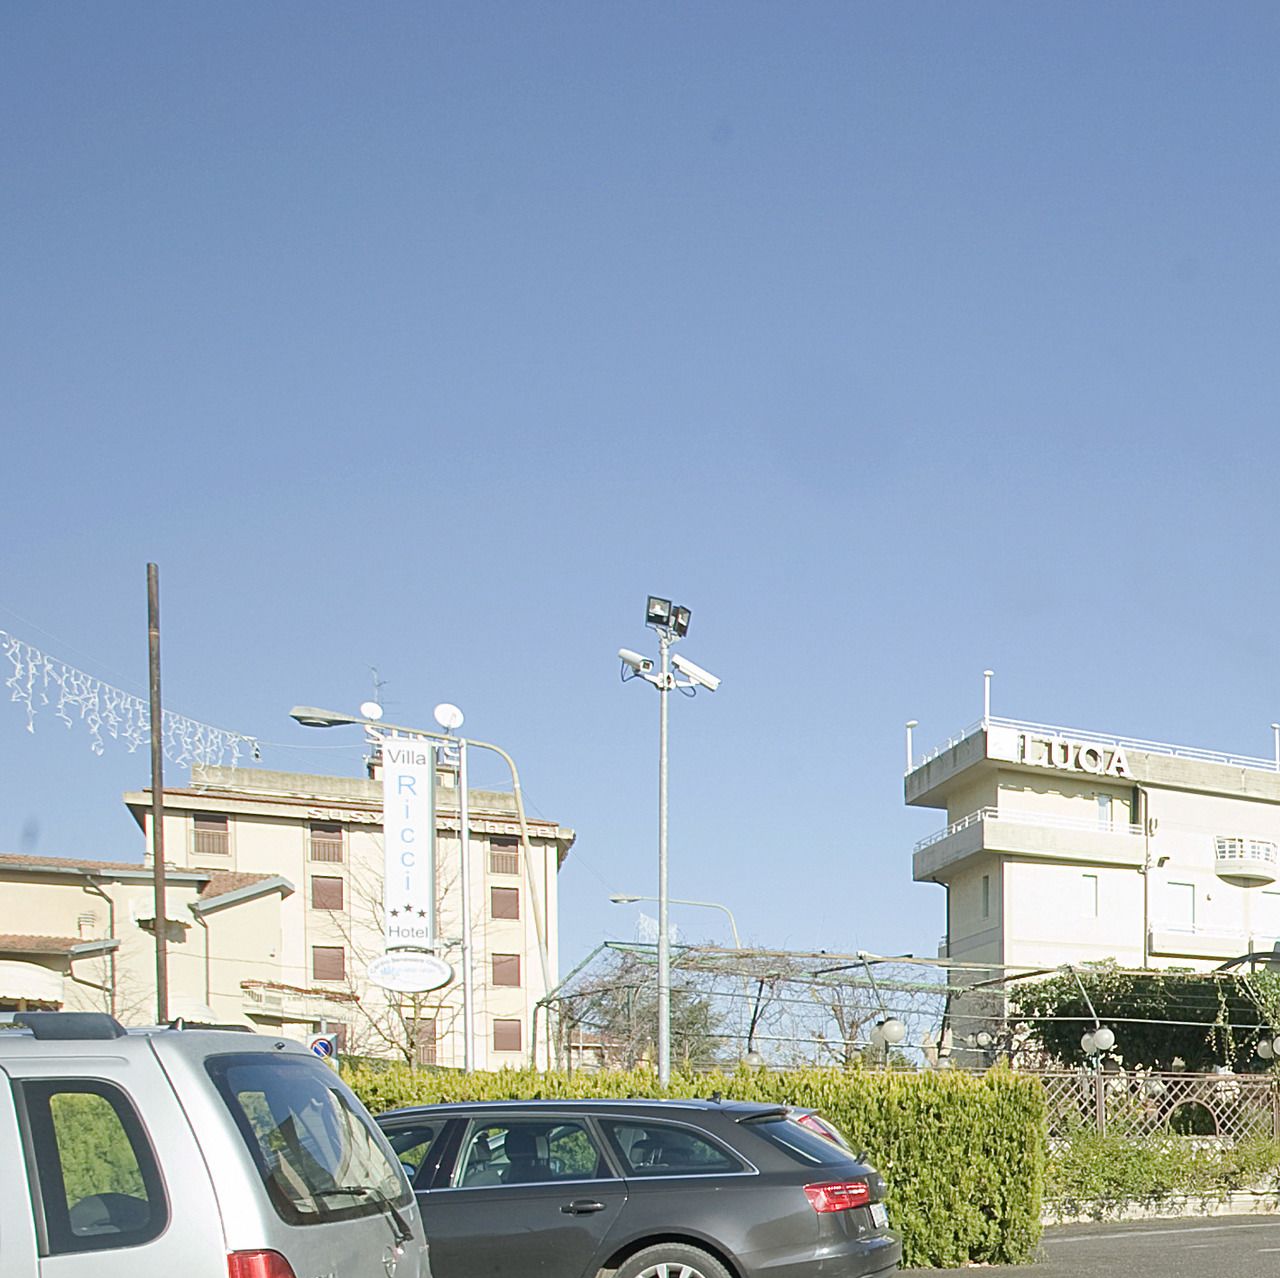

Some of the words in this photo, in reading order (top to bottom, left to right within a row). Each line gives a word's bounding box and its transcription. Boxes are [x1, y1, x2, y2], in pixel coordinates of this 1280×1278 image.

[388, 749, 427, 765] Villa
[397, 775, 417, 890] Ricci
[388, 925, 429, 939] Hotel
